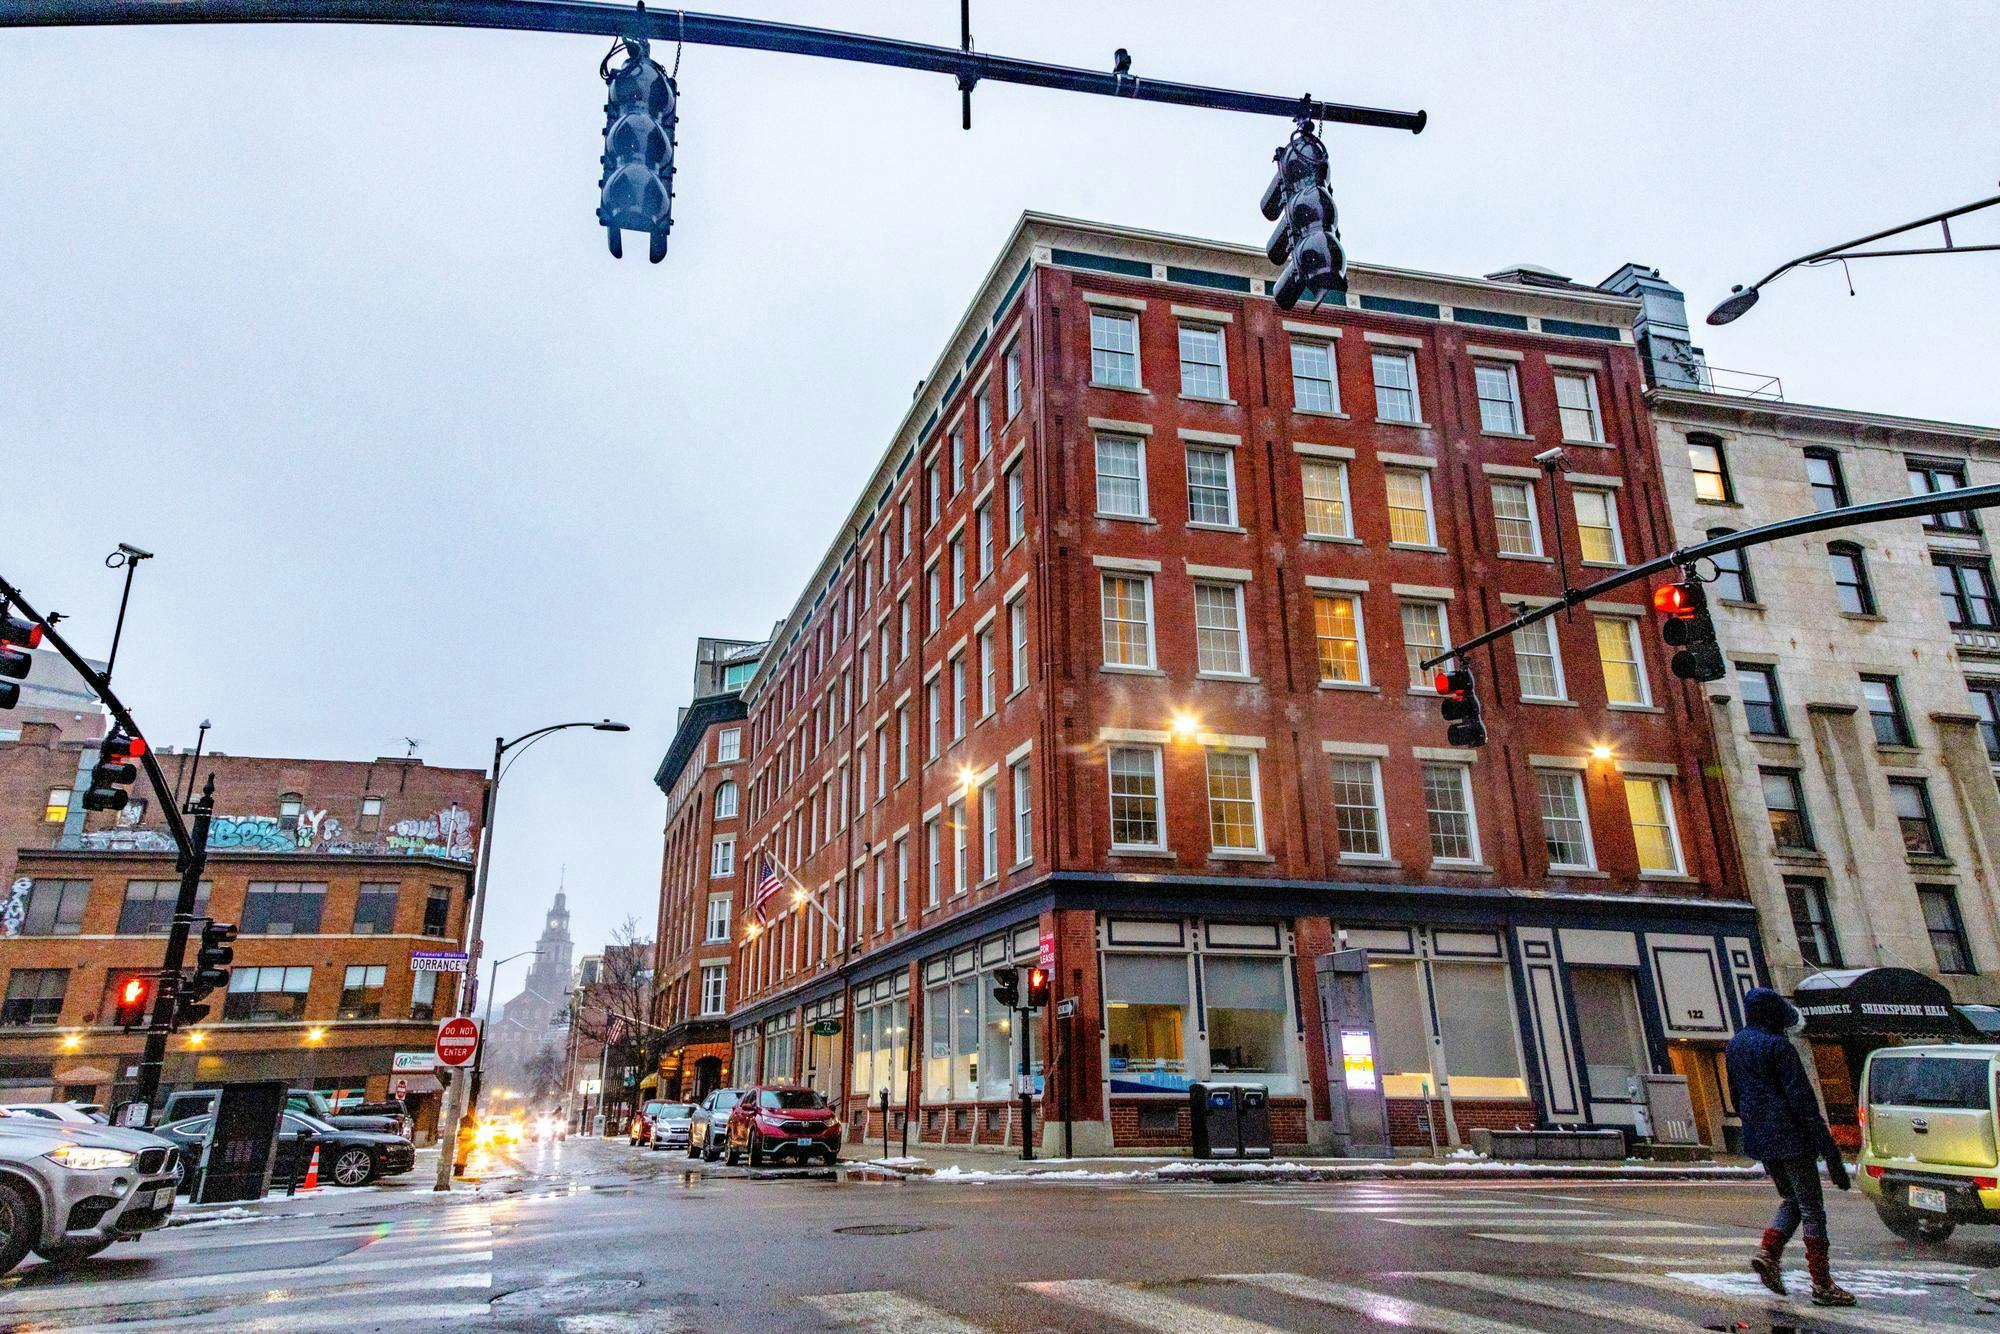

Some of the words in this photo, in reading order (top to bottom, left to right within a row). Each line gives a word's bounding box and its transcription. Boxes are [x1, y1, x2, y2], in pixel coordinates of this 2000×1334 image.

[412, 959, 461, 970] DORRANCE
[1687, 1009, 1704, 1019] 122
[1809, 1005, 1842, 1016] DORRANCE
[1841, 1004, 1852, 1014] ST.
[1861, 1003, 1923, 1016] SHAKESPEARE
[1924, 1005, 1949, 1017] HALL
[445, 1027, 456, 1035] DO
[460, 1027, 474, 1035] NOT
[823, 1022, 831, 1031] 72
[443, 1048, 467, 1056] ENTER
